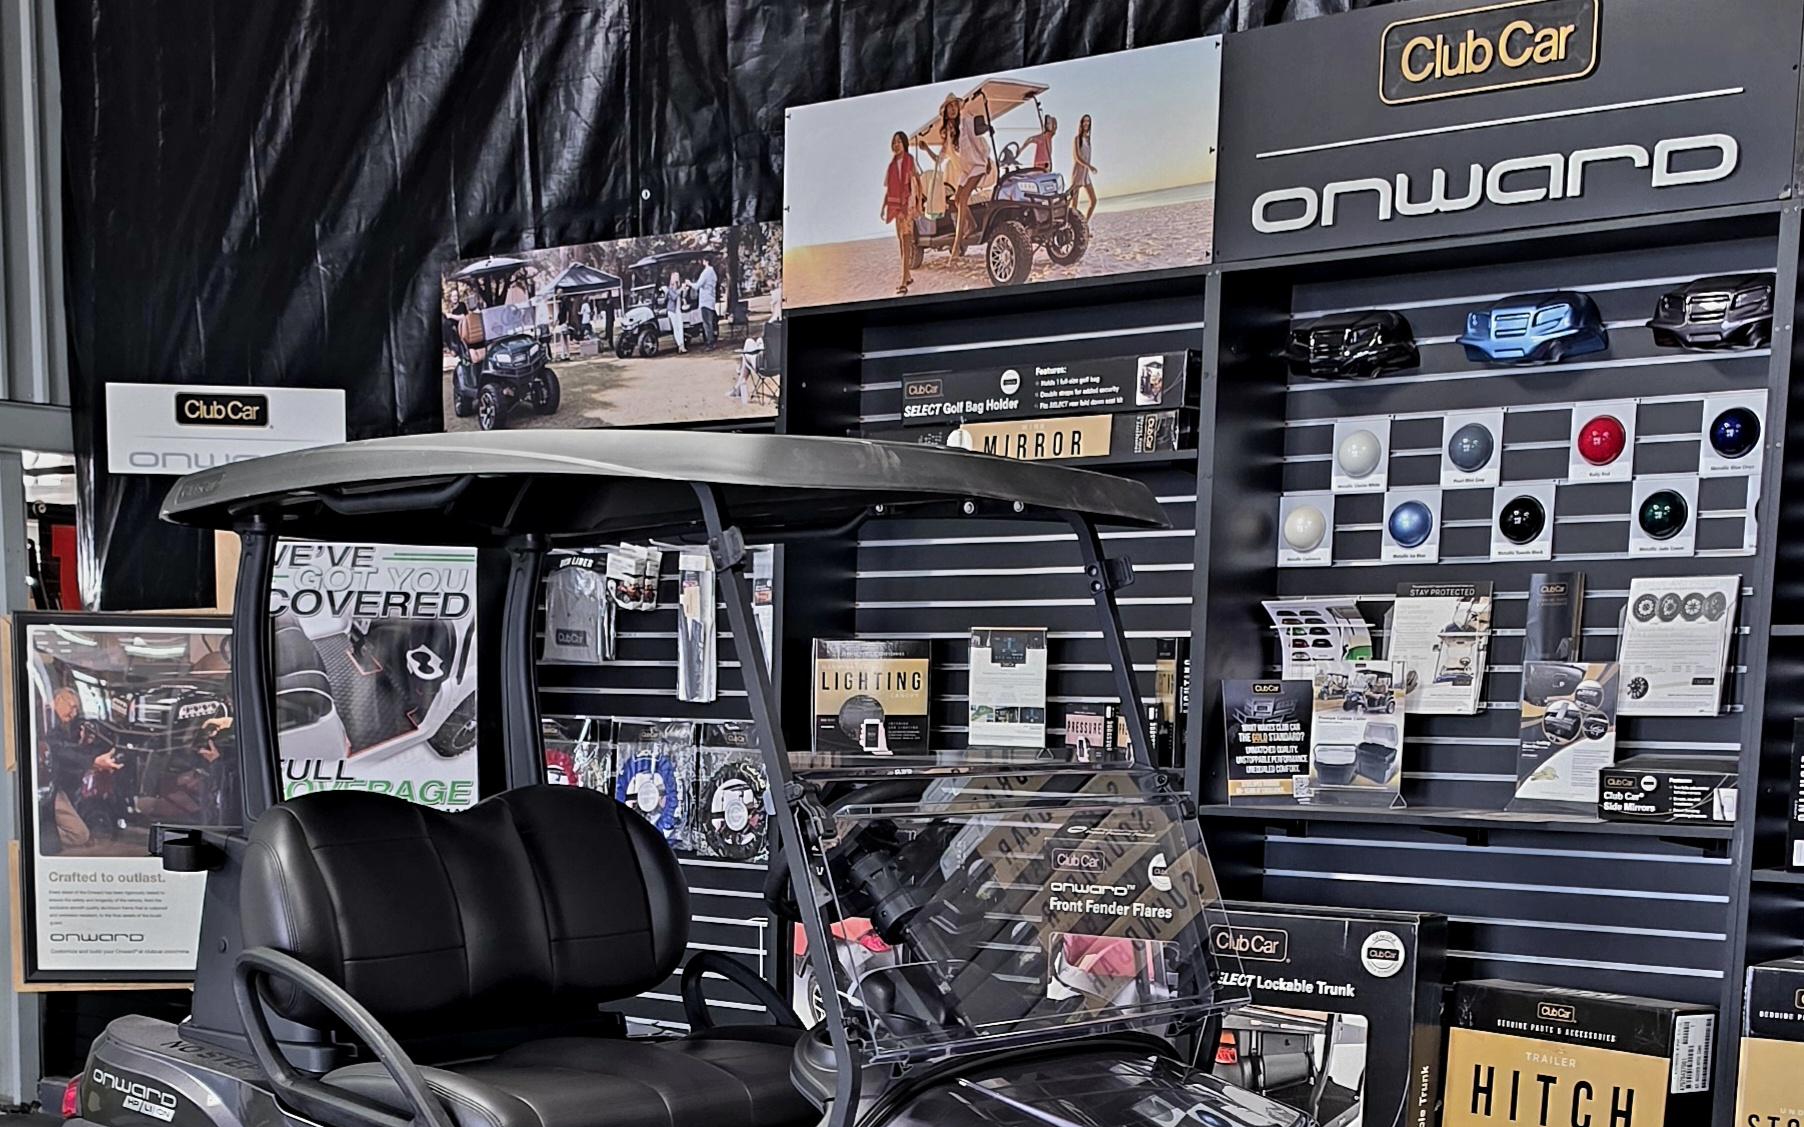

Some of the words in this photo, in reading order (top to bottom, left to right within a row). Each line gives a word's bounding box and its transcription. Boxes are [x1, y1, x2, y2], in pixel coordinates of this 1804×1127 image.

[1401, 30, 1492, 83] Club
[1498, 20, 1575, 68] Car
[184, 400, 226, 420] Club
[227, 401, 260, 421] Car
[904, 403, 942, 418] SELECT
[943, 401, 965, 415] Golf
[966, 400, 984, 414] Bag
[986, 397, 1020, 412] Holder
[984, 430, 1082, 459] MIRROR
[293, 566, 379, 593] GOT
[388, 567, 469, 593] YOU
[1410, 588, 1429, 597] STAY
[1430, 587, 1476, 597] PROTECTED
[269, 588, 471, 619] COVERED
[821, 671, 922, 691] LIGHTING
[1067, 720, 1103, 736] PRESSURE
[281, 758, 355, 782] ULL
[1603, 791, 1624, 801] Club
[1603, 802, 1623, 811] Side
[1624, 803, 1656, 813] Mirrors
[1057, 853, 1080, 867] Club
[1081, 854, 1100, 868] Car
[49, 871, 97, 883] Crafted
[102, 873, 114, 883] to
[118, 872, 166, 883] outlast.
[1049, 897, 1083, 913] Front
[1085, 899, 1129, 916] Fender
[1132, 902, 1173, 919] Flares
[1216, 931, 1250, 951] Club
[1251, 935, 1279, 954] Car
[1256, 975, 1314, 994] Lockable
[1315, 980, 1356, 998] Trunk
[1526, 1051, 1577, 1068] TRAILER
[1419, 1065, 1430, 1107] Trunk
